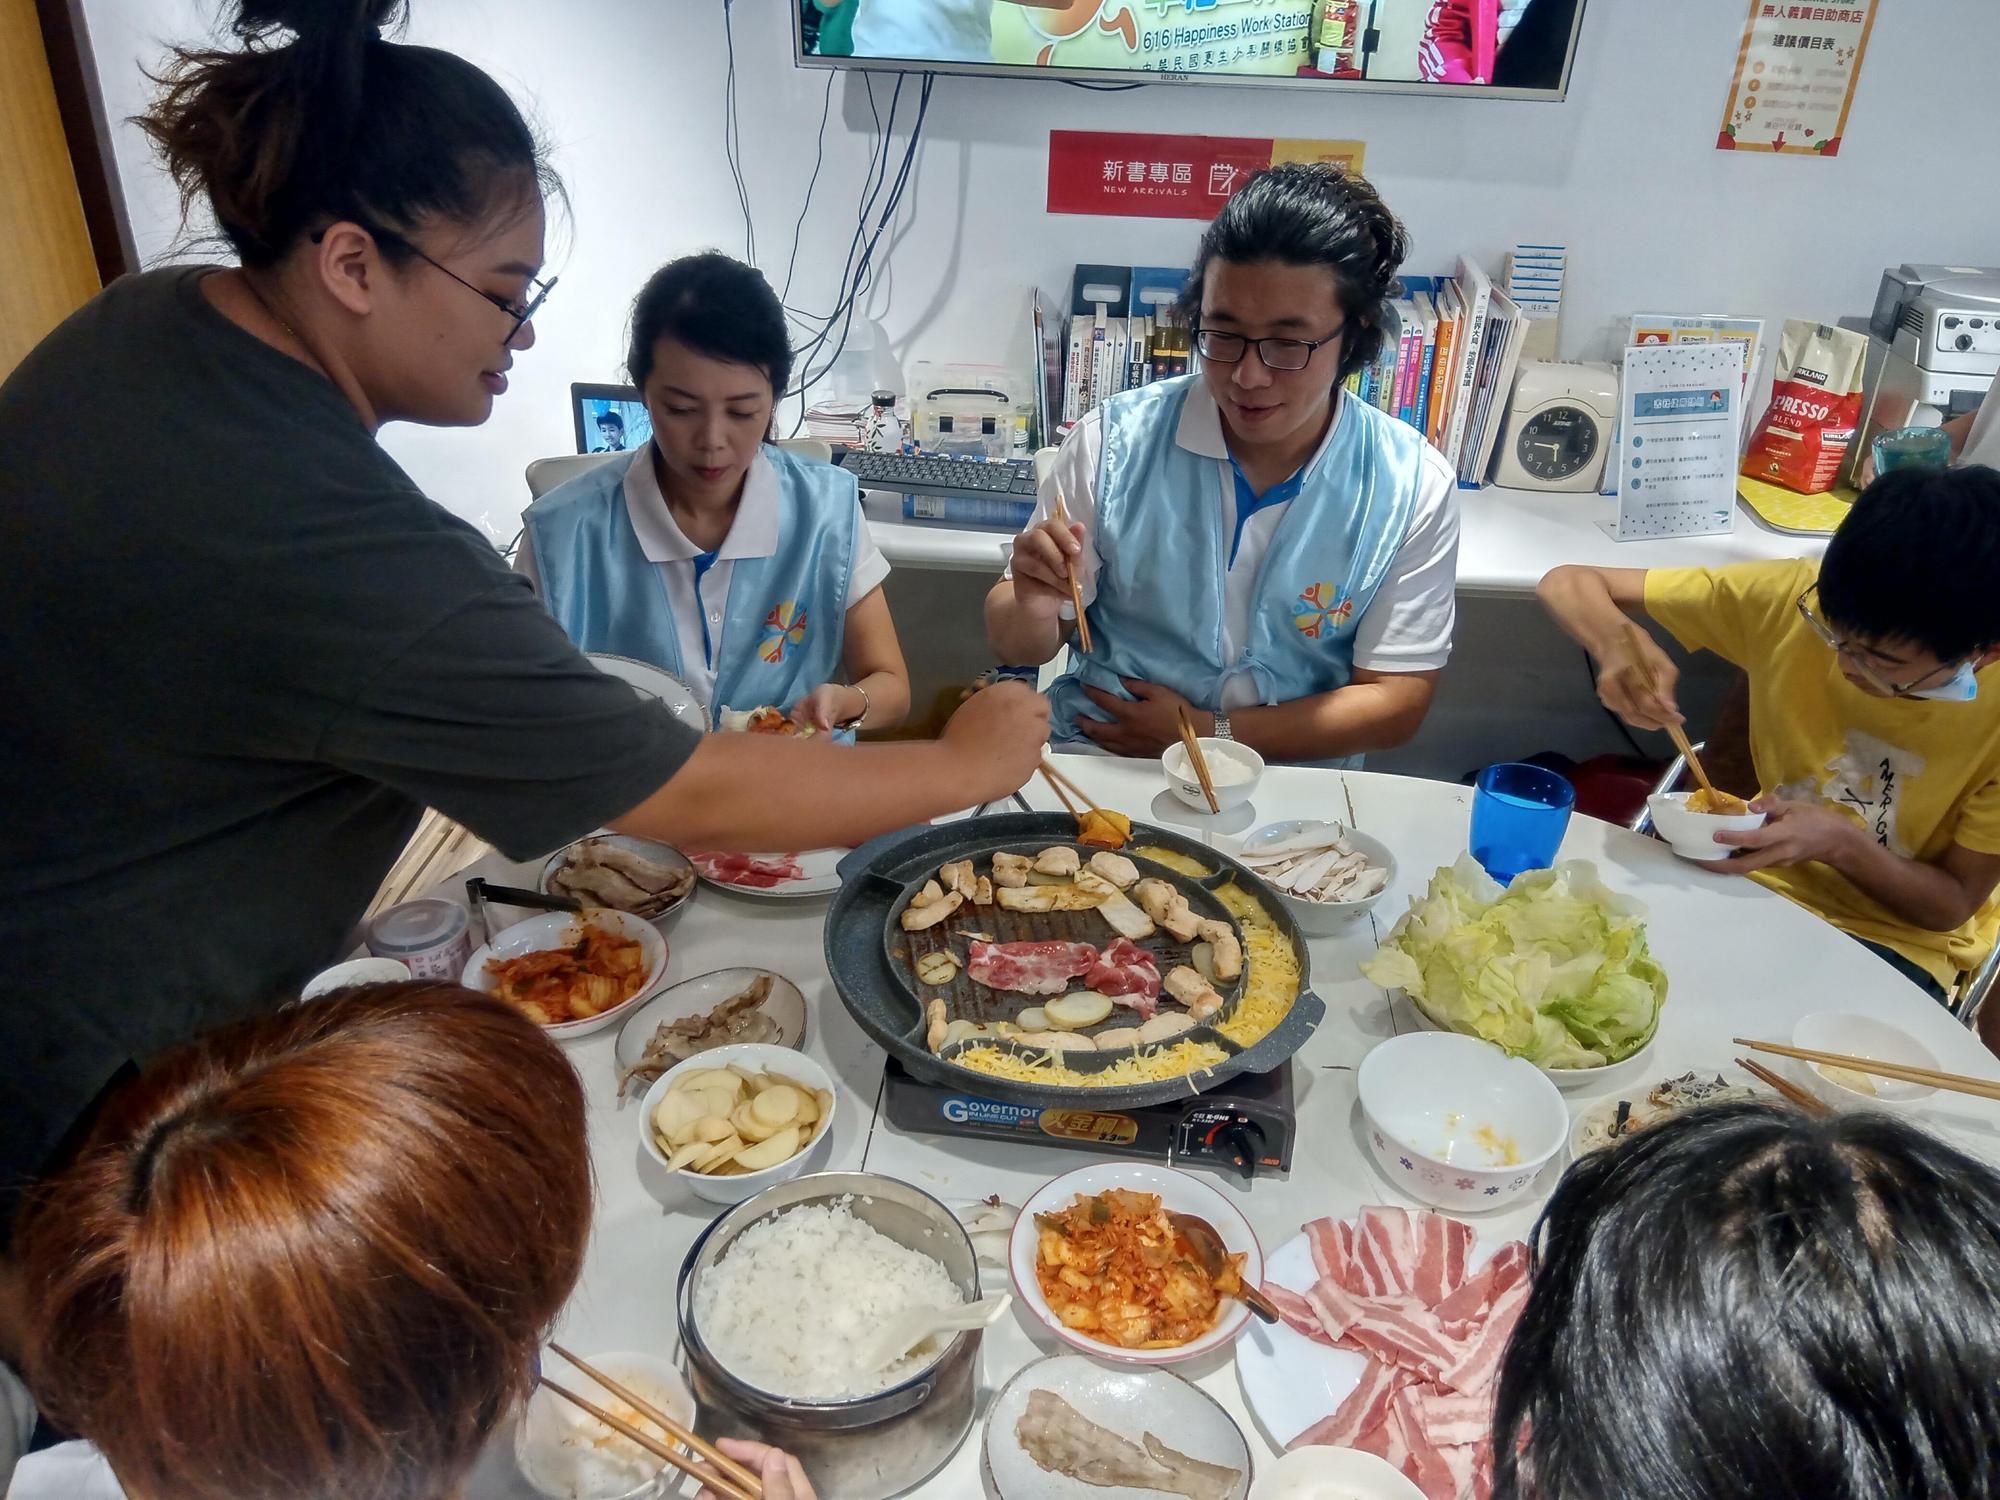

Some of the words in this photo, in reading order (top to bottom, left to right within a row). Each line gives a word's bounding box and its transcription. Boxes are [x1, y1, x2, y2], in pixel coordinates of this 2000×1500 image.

[1143, 29, 1171, 49] 616
[1174, 22, 1237, 46] Happiness
[1241, 16, 1272, 34] Work
[1273, 12, 1311, 29] Station
[1772, 34, 1836, 50] 建議價目表
[1102, 160, 1193, 185] 新書專區
[1103, 186, 1127, 195] NEW
[1132, 186, 1189, 196] ARRIVALS
[1543, 414, 1552, 422] 11
[1559, 411, 1568, 420] 12
[1773, 415, 1802, 427] BLEND
[1529, 426, 1538, 435] 10
[1584, 430, 1591, 439] 2
[1524, 440, 1530, 448] 9
[1535, 462, 1542, 470] 7
[1875, 758, 1894, 847] AMERICA
[943, 1099, 1039, 1122] Governor
